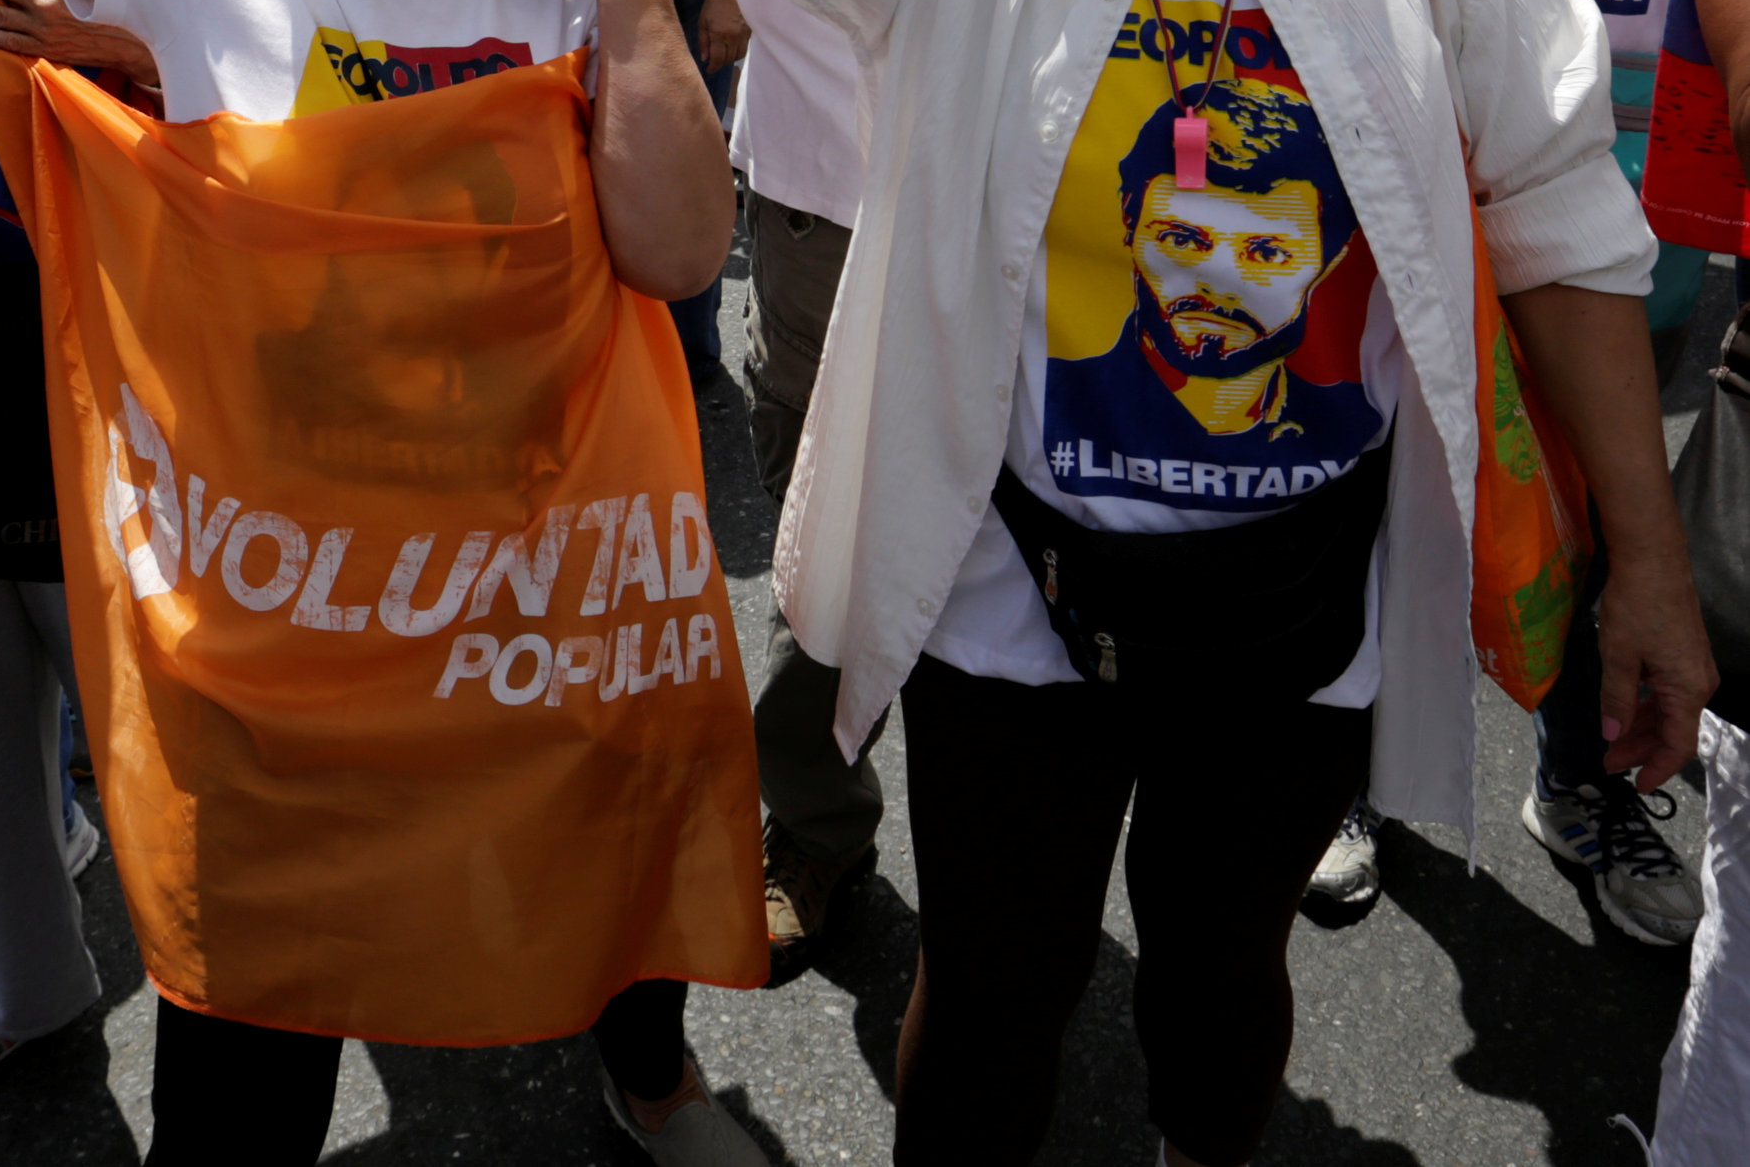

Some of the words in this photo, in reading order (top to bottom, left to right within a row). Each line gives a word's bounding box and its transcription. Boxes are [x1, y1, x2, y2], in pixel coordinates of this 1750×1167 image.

[1050, 438, 1360, 499] #LIBERTADY
[187, 473, 712, 637] VOLUNTAD
[432, 613, 723, 708] POPULAR
